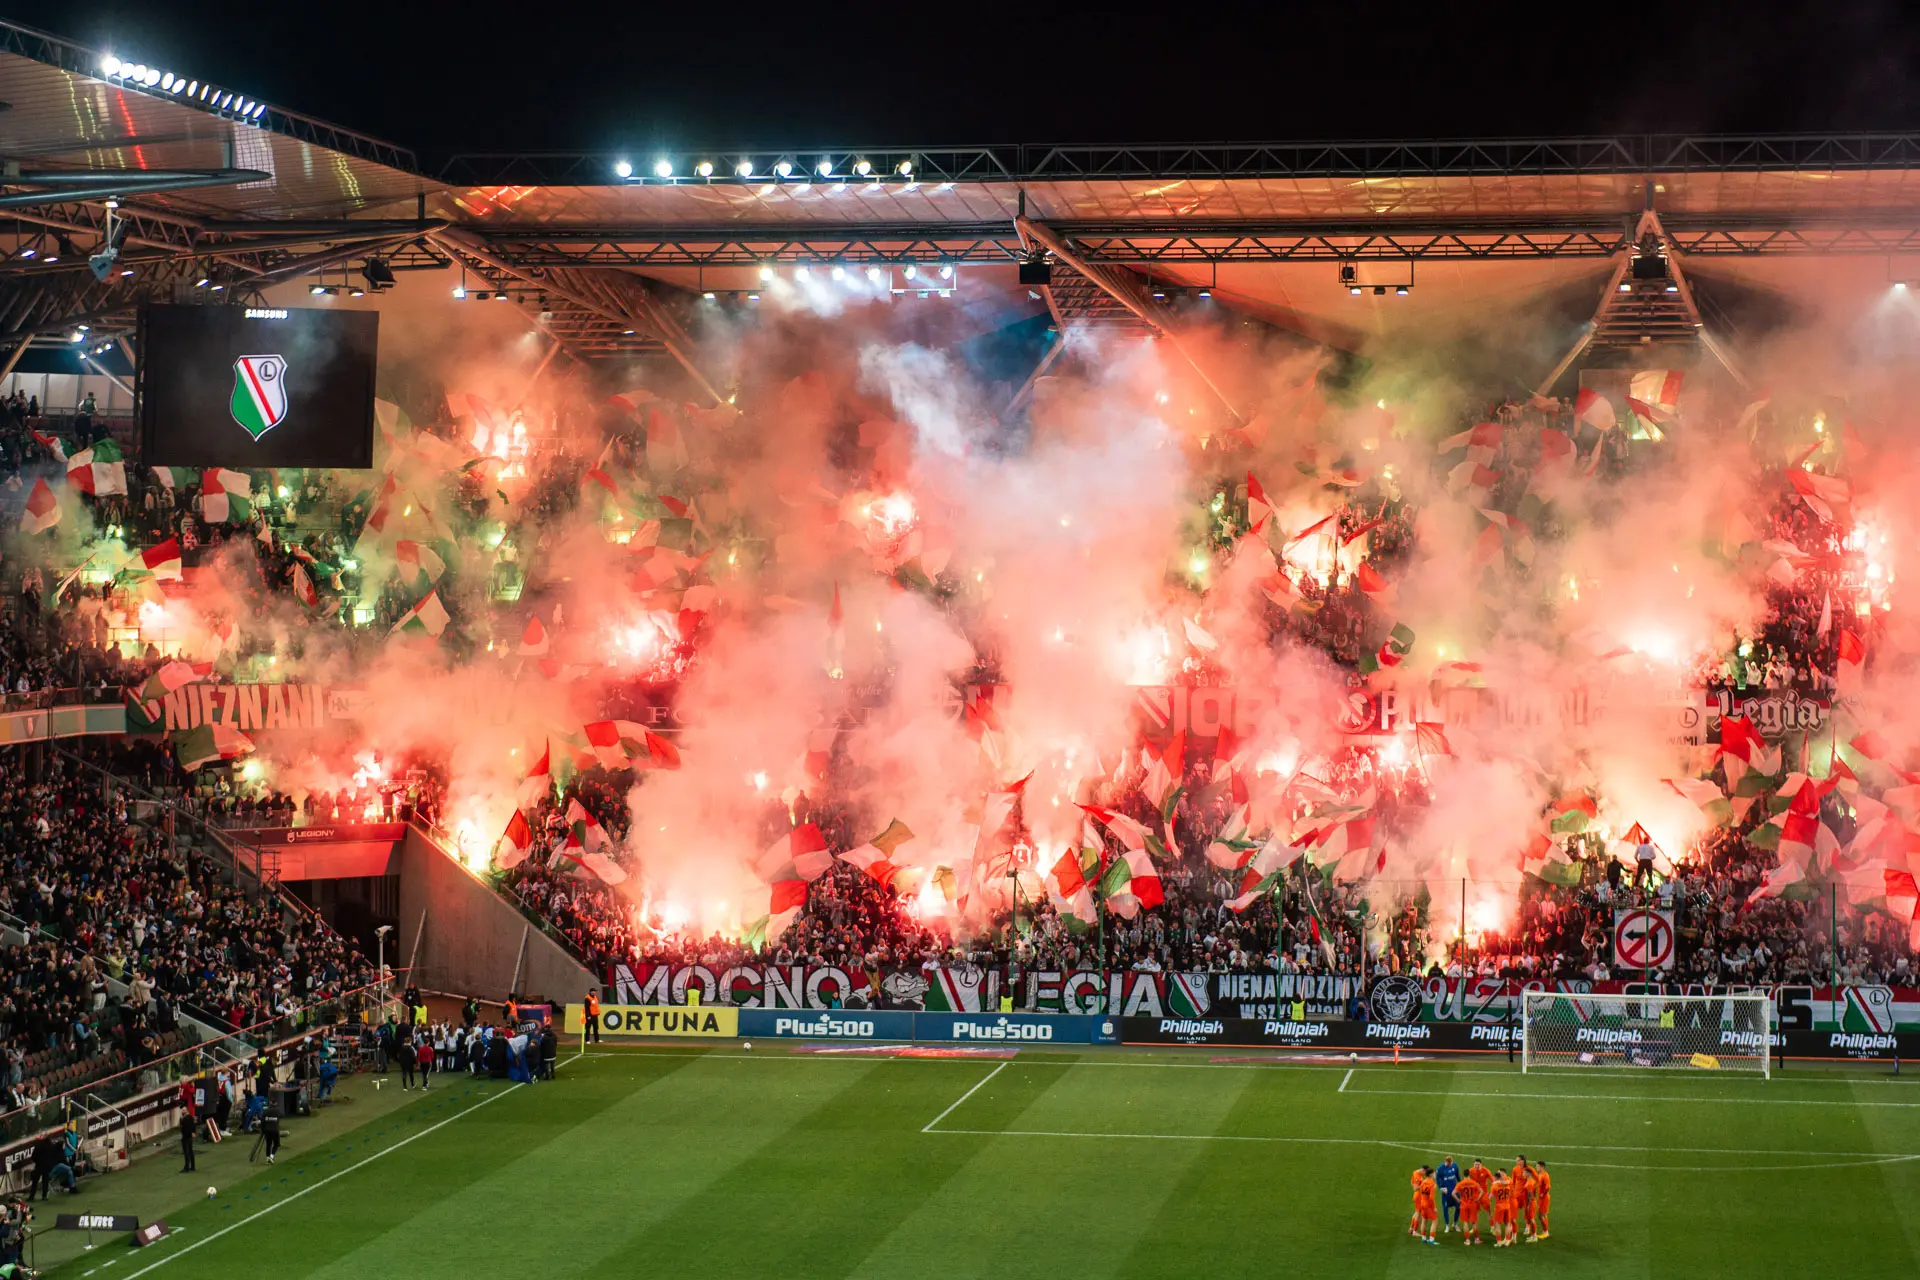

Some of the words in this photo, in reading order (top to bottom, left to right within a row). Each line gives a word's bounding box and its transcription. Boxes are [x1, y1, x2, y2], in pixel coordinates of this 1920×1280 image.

[245, 308, 288, 319] SAMSUNG
[164, 684, 324, 730] NIEZNANI
[1711, 689, 1823, 738] Legia
[296, 830, 335, 838] LEGIONY
[615, 964, 851, 1009] MOCNO
[1219, 974, 1362, 1000] NIENAWIDZIMY
[516, 1022, 536, 1032] LOTTO
[603, 1010, 720, 1032] ORTUNA
[776, 1016, 875, 1036] Plus500
[1160, 1020, 1224, 1035] Philipiak
[953, 1020, 1053, 1040] Plus500
[1264, 1021, 1329, 1038] Philipiak
[1365, 1024, 1431, 1040] Philipiak
[1470, 1026, 1525, 1042] Philipia
[1576, 1029, 1642, 1044] Philipiak
[1830, 1033, 1897, 1049] Philipiak
